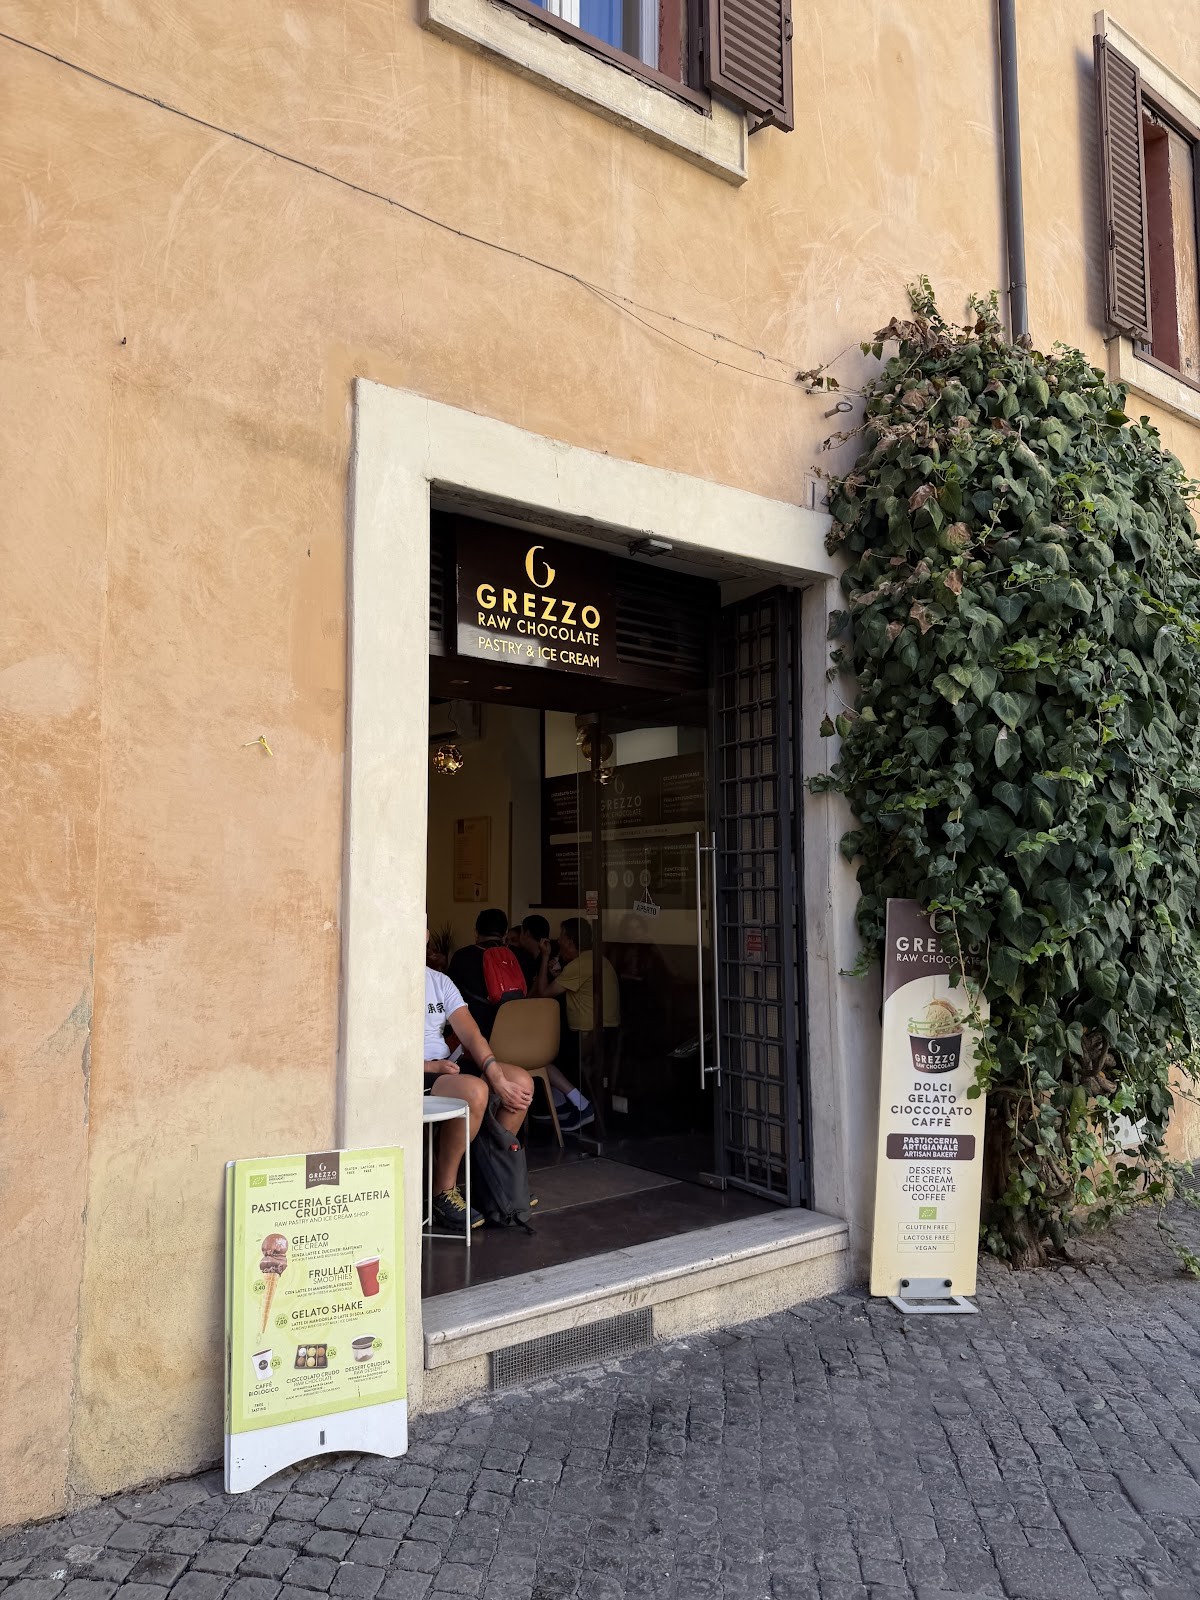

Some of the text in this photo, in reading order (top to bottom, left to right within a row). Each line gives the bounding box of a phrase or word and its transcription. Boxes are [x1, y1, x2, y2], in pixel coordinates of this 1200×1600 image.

[476, 583, 600, 629] GREZZO
[478, 612, 599, 646] RAW CHOCOLATE
[478, 636, 599, 668] PASTRY & ICE CREAM
[636, 904, 657, 915] APERTO
[896, 936, 980, 955] GREO
[896, 953, 981, 965] RAW CHOCOATE
[914, 1053, 956, 1064] GREZZO
[926, 1062, 955, 1070] CHOCOLATE
[914, 1082, 952, 1092] DOLCI
[908, 1094, 957, 1104] GELATO
[891, 1105, 973, 1116] CIOCCOLATO
[911, 1115, 951, 1127] CAFFÈ
[902, 1143, 959, 1151] ARTIGIANALE
[308, 1171, 337, 1179] GREZZO
[909, 1166, 952, 1174] DESSERTS
[905, 1175, 954, 1184] ICE CREAM
[902, 1184, 957, 1192] CHOCOLATE
[251, 1190, 390, 1214] PASTICCERIA E GELATERIA
[911, 1193, 946, 1201] COFFEE
[295, 1204, 350, 1219] CRUDISTA
[275, 1220, 288, 1228] RAW
[289, 1218, 310, 1226] PASTRY
[333, 1213, 354, 1221] CREAM
[292, 1233, 329, 1245] GELATO
[292, 1241, 329, 1251] ICE CREAM
[309, 1265, 352, 1279] FRULLATI
[313, 1273, 353, 1284] SMOOTHIES
[292, 1300, 363, 1320] GELATO SHAKE
[345, 1360, 390, 1373] DESSERT CRUDISTA
[286, 1373, 320, 1384] CIOCCOLATO
[321, 1369, 340, 1378] CRUDO
[305, 1376, 332, 1385] CHOCOLATE
[255, 1381, 272, 1390] CAFFÈ
[248, 1386, 279, 1397] BIOLOGICO
